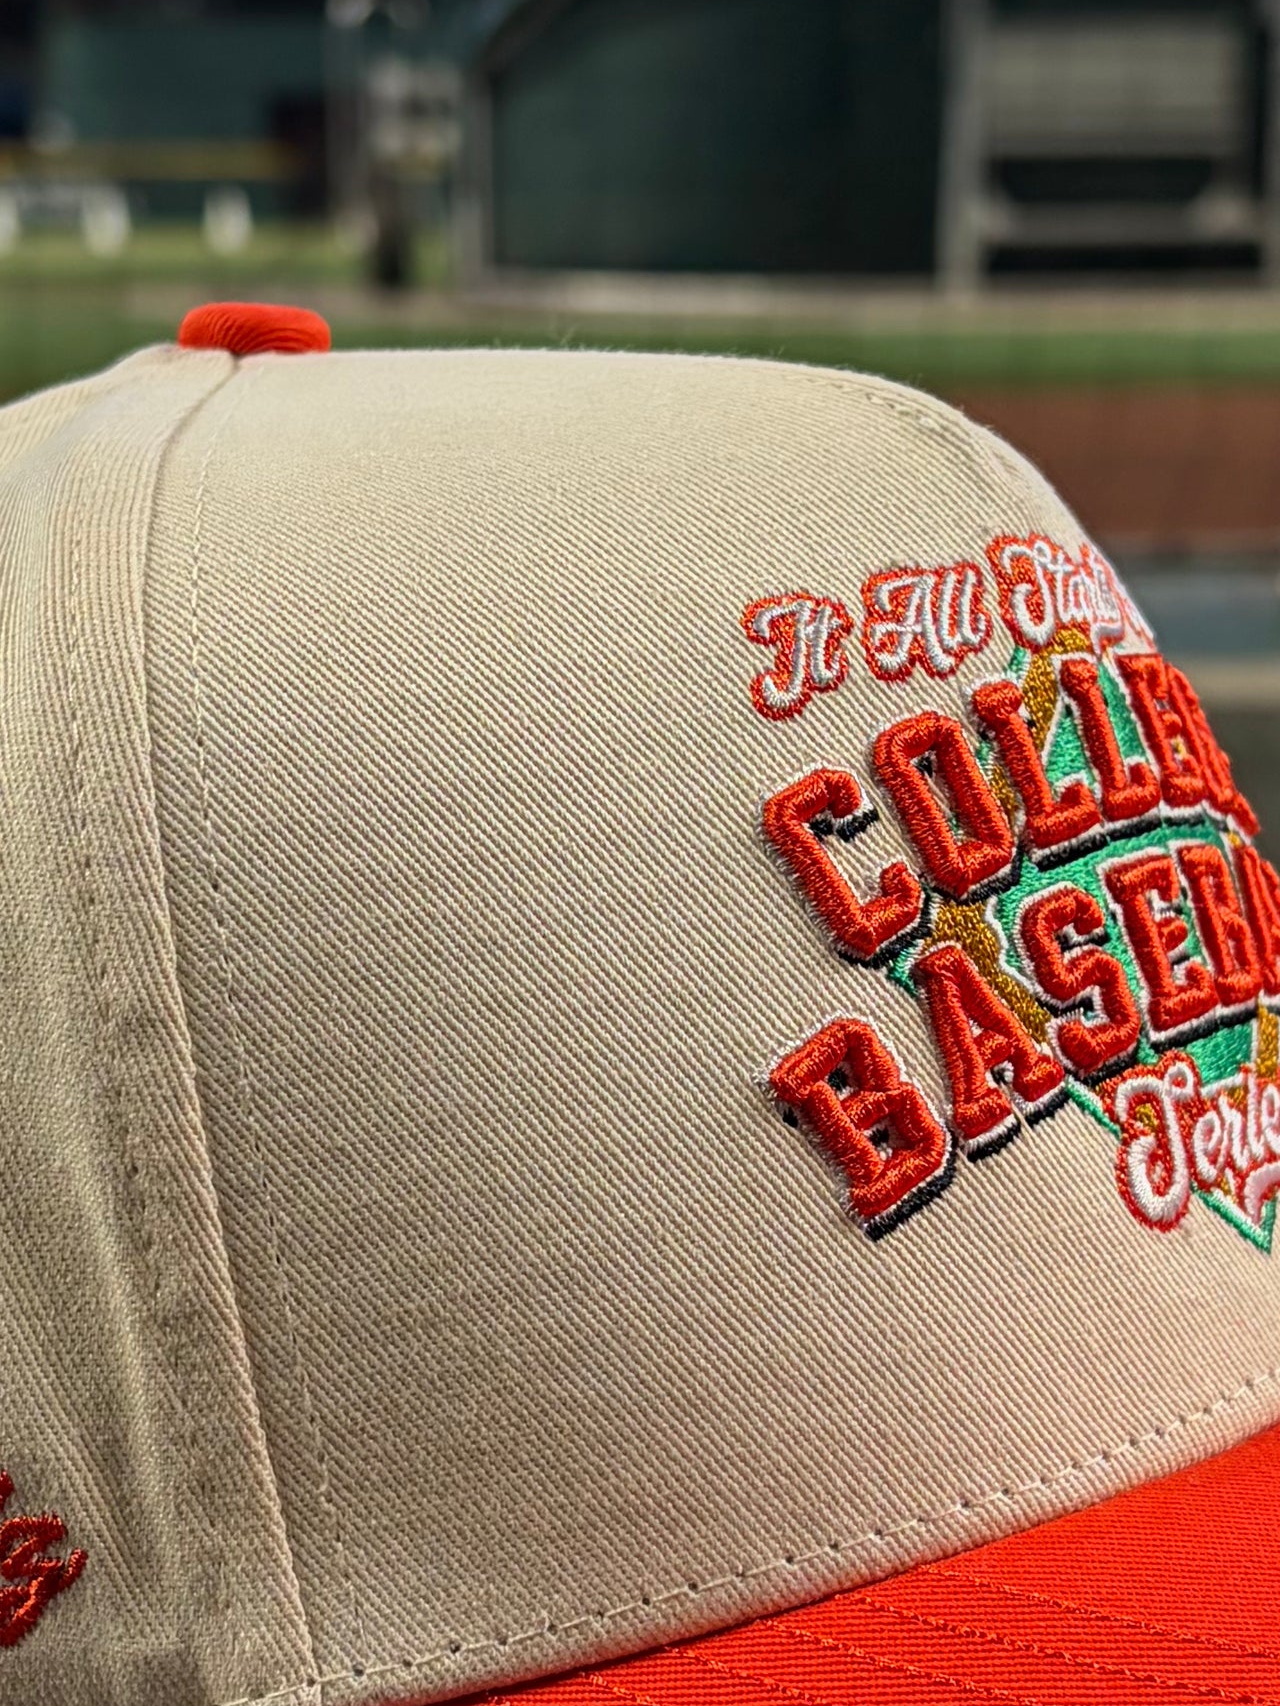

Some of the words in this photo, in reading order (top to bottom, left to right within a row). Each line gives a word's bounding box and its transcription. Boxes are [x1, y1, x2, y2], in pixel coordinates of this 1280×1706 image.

[741, 591, 853, 720] It
[859, 560, 993, 682] All
[758, 652, 1262, 967] COLLEG
